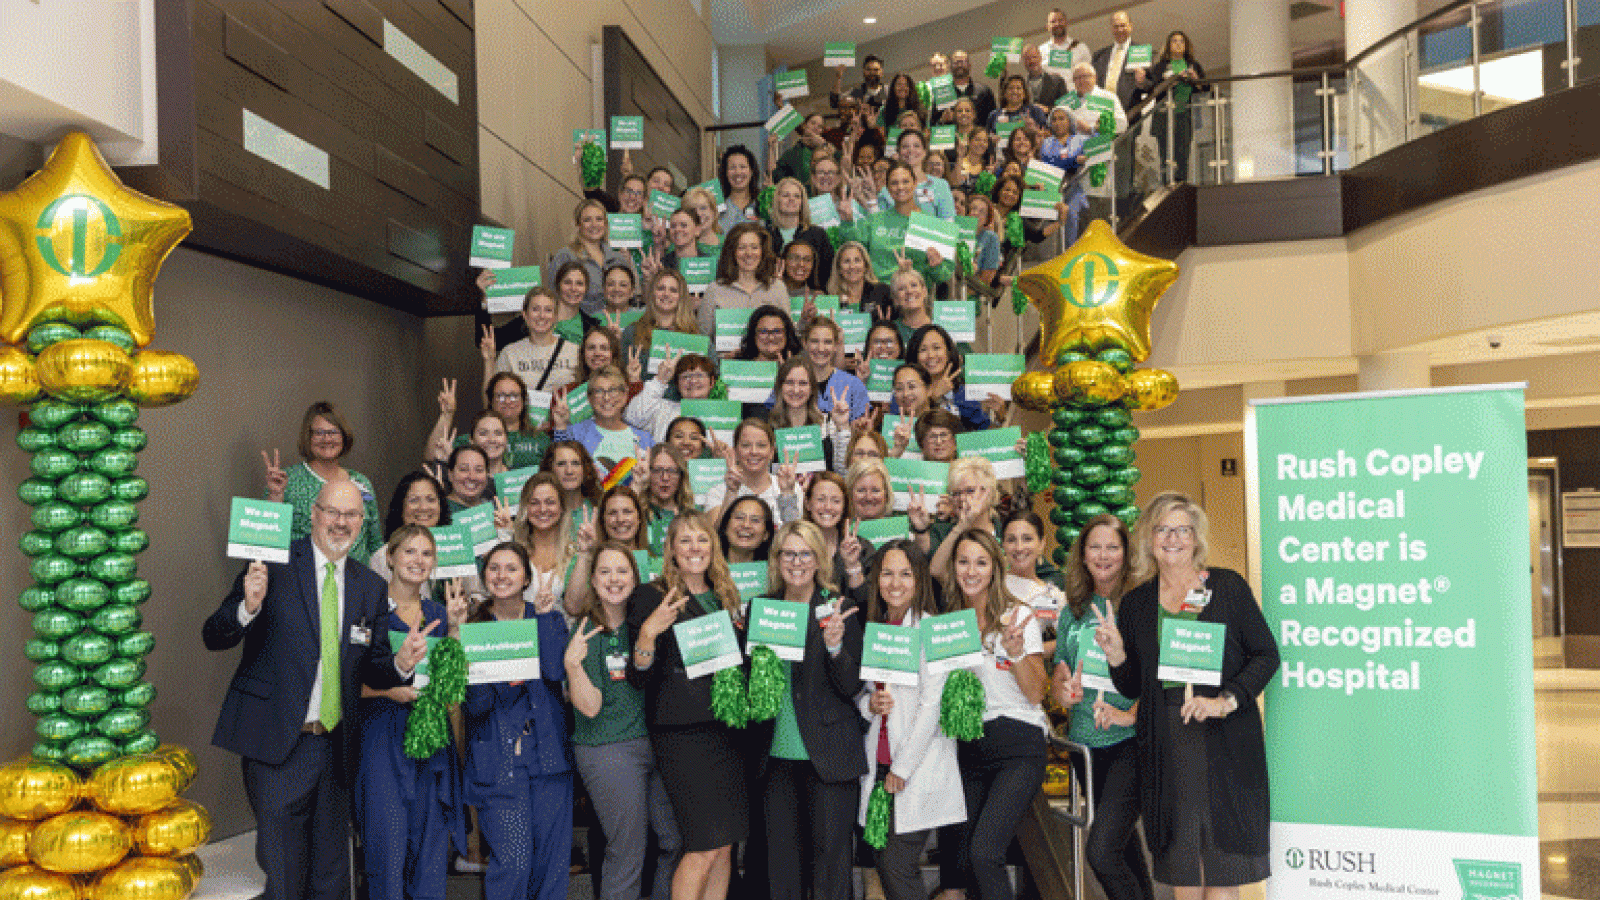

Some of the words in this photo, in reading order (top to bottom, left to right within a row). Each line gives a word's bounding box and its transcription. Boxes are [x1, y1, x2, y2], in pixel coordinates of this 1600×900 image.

[1276, 449, 1357, 480] Rush
[1366, 444, 1485, 481] Copley
[244, 506, 261, 517] We
[262, 510, 280, 519] are
[1277, 489, 1405, 522] Medical
[239, 518, 282, 532] Magnet.
[1278, 534, 1390, 563] Center
[1398, 531, 1428, 562] is
[1279, 582, 1297, 605] a
[763, 606, 779, 616] We
[780, 609, 797, 619] are
[687, 625, 702, 635] We
[704, 622, 720, 632] are
[759, 618, 798, 631] Magnet.
[931, 622, 948, 632] We
[949, 620, 966, 629] are
[687, 632, 725, 648] Magnet.
[877, 631, 892, 641] We
[894, 635, 911, 643] are
[931, 630, 970, 644] Magnet.
[1174, 628, 1192, 638] We
[1193, 631, 1213, 640] are
[1280, 618, 1477, 653] Recognized
[871, 643, 912, 656] Magnet.
[1170, 639, 1214, 653] Magnet.
[1281, 660, 1421, 695] Hospital
[1308, 849, 1376, 874] RUSH
[1468, 869, 1514, 880] MAGNET
[1309, 877, 1333, 889] Rush
[1334, 879, 1366, 891] Copley
[1368, 881, 1405, 893] Medical
[1407, 884, 1440, 895] Center
